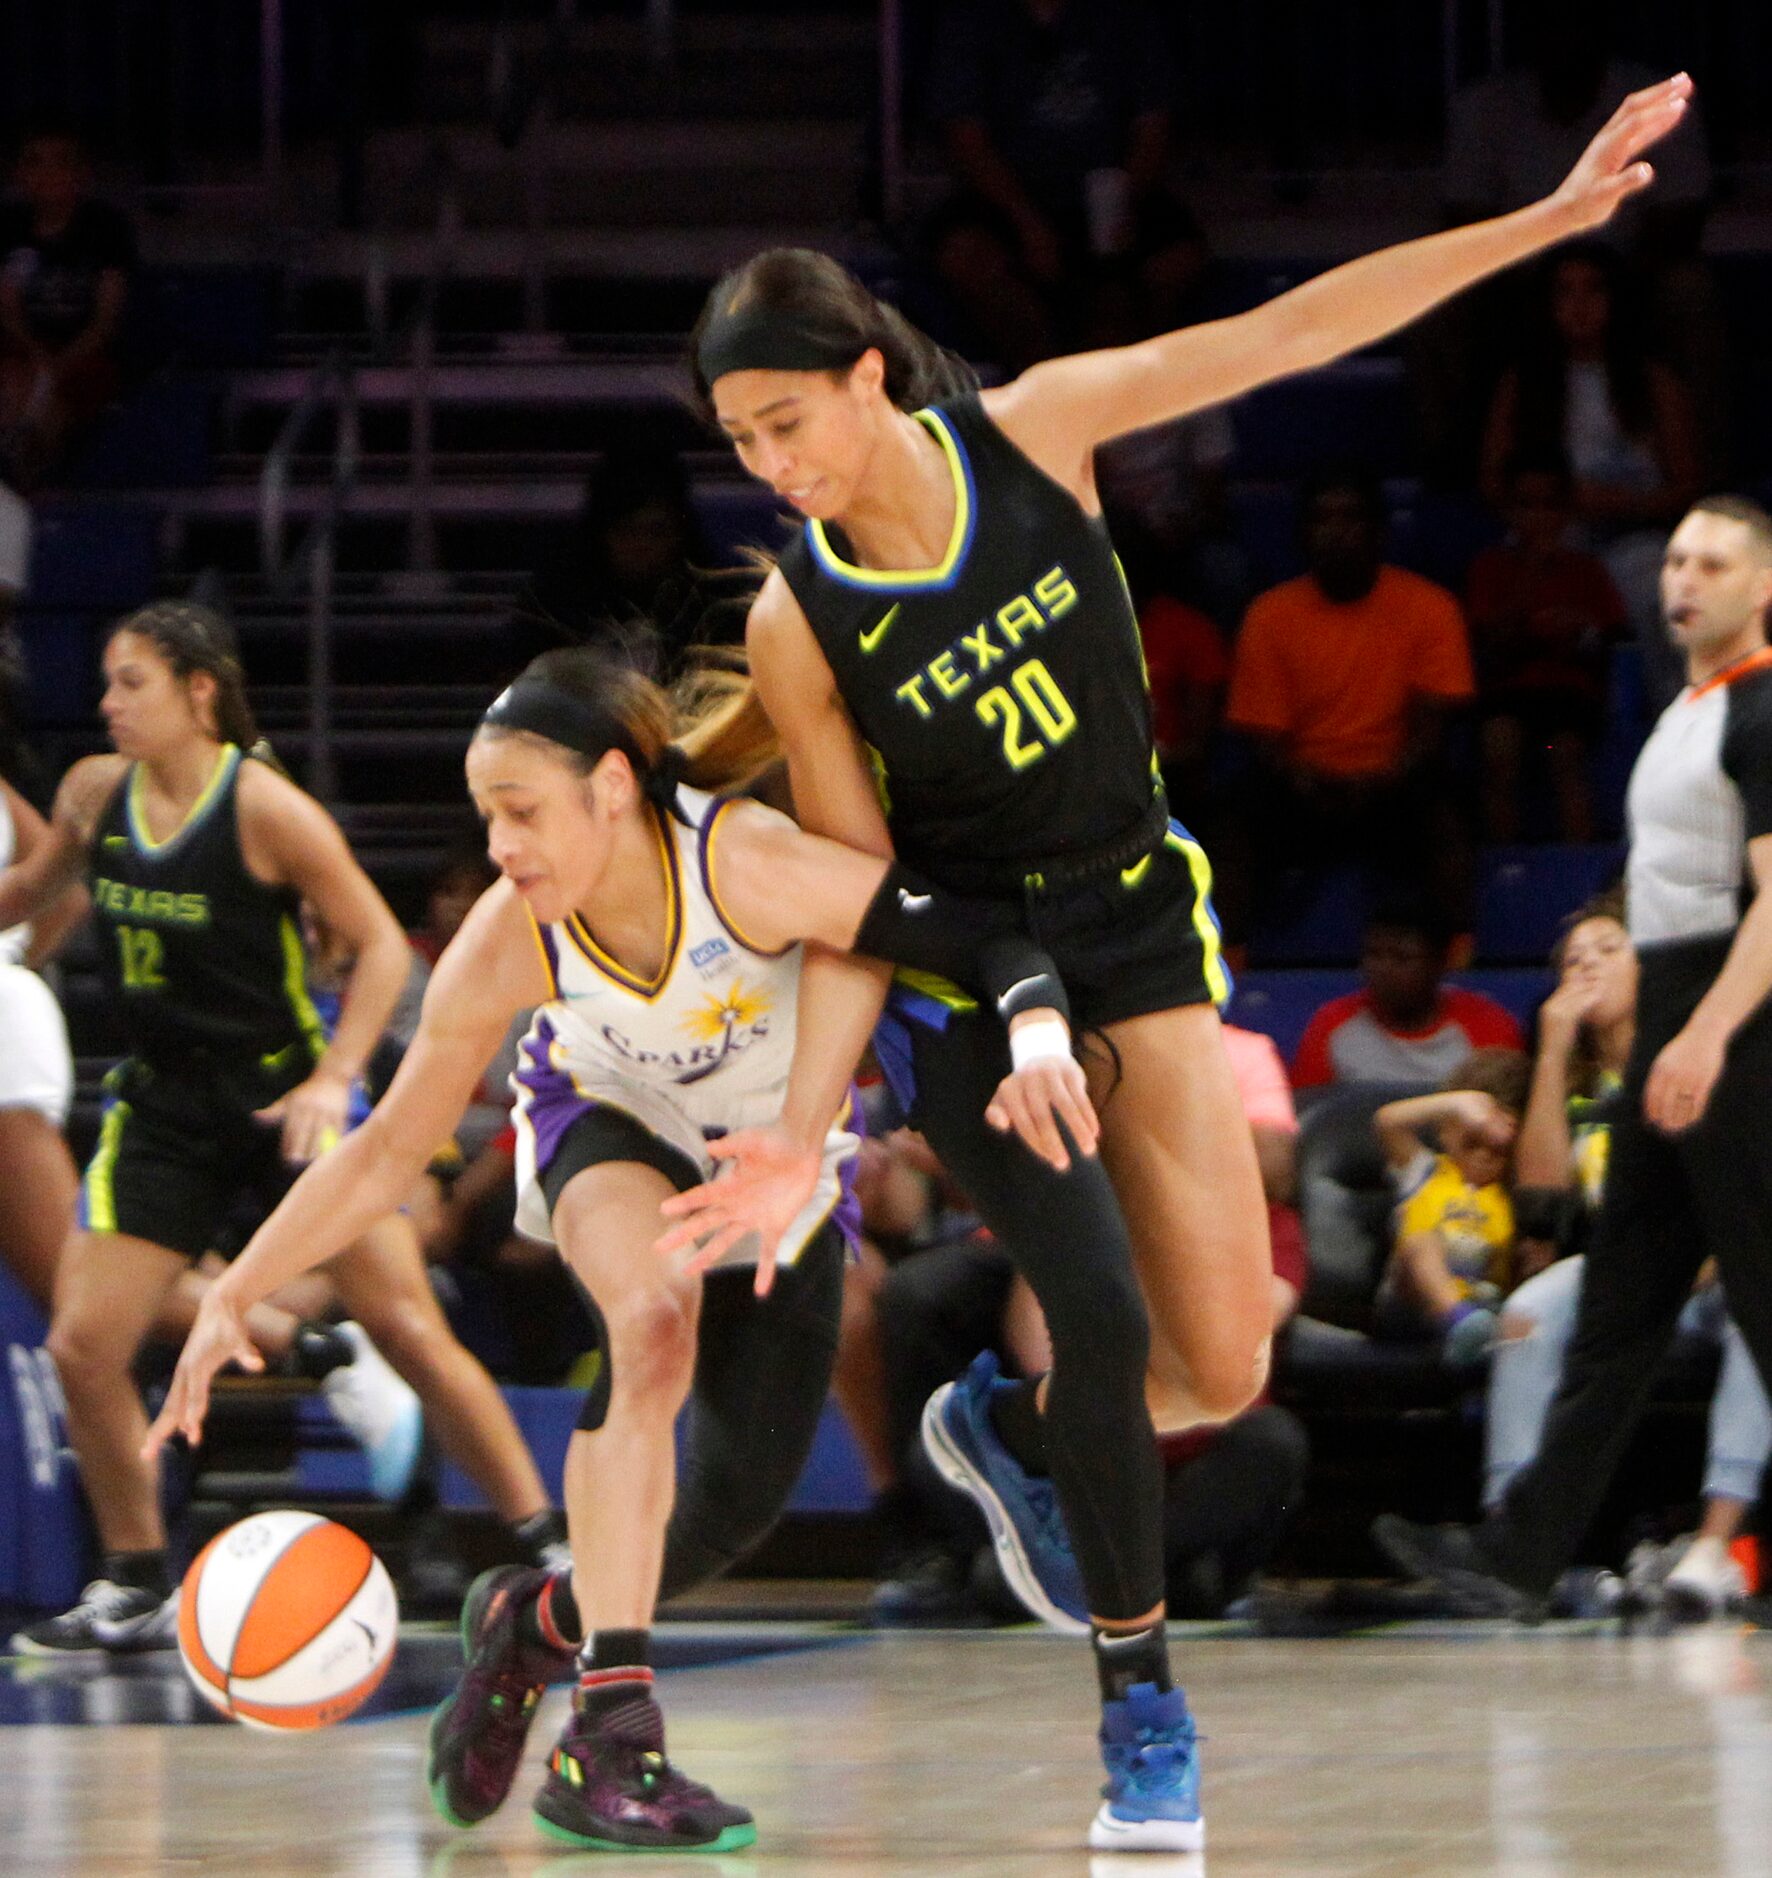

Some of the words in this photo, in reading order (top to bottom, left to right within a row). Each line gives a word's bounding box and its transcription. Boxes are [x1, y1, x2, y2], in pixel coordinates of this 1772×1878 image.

[896, 565, 1078, 719] TEXAS
[975, 658, 1077, 768] 20
[96, 878, 208, 923] TEXAS
[117, 925, 166, 986] 12
